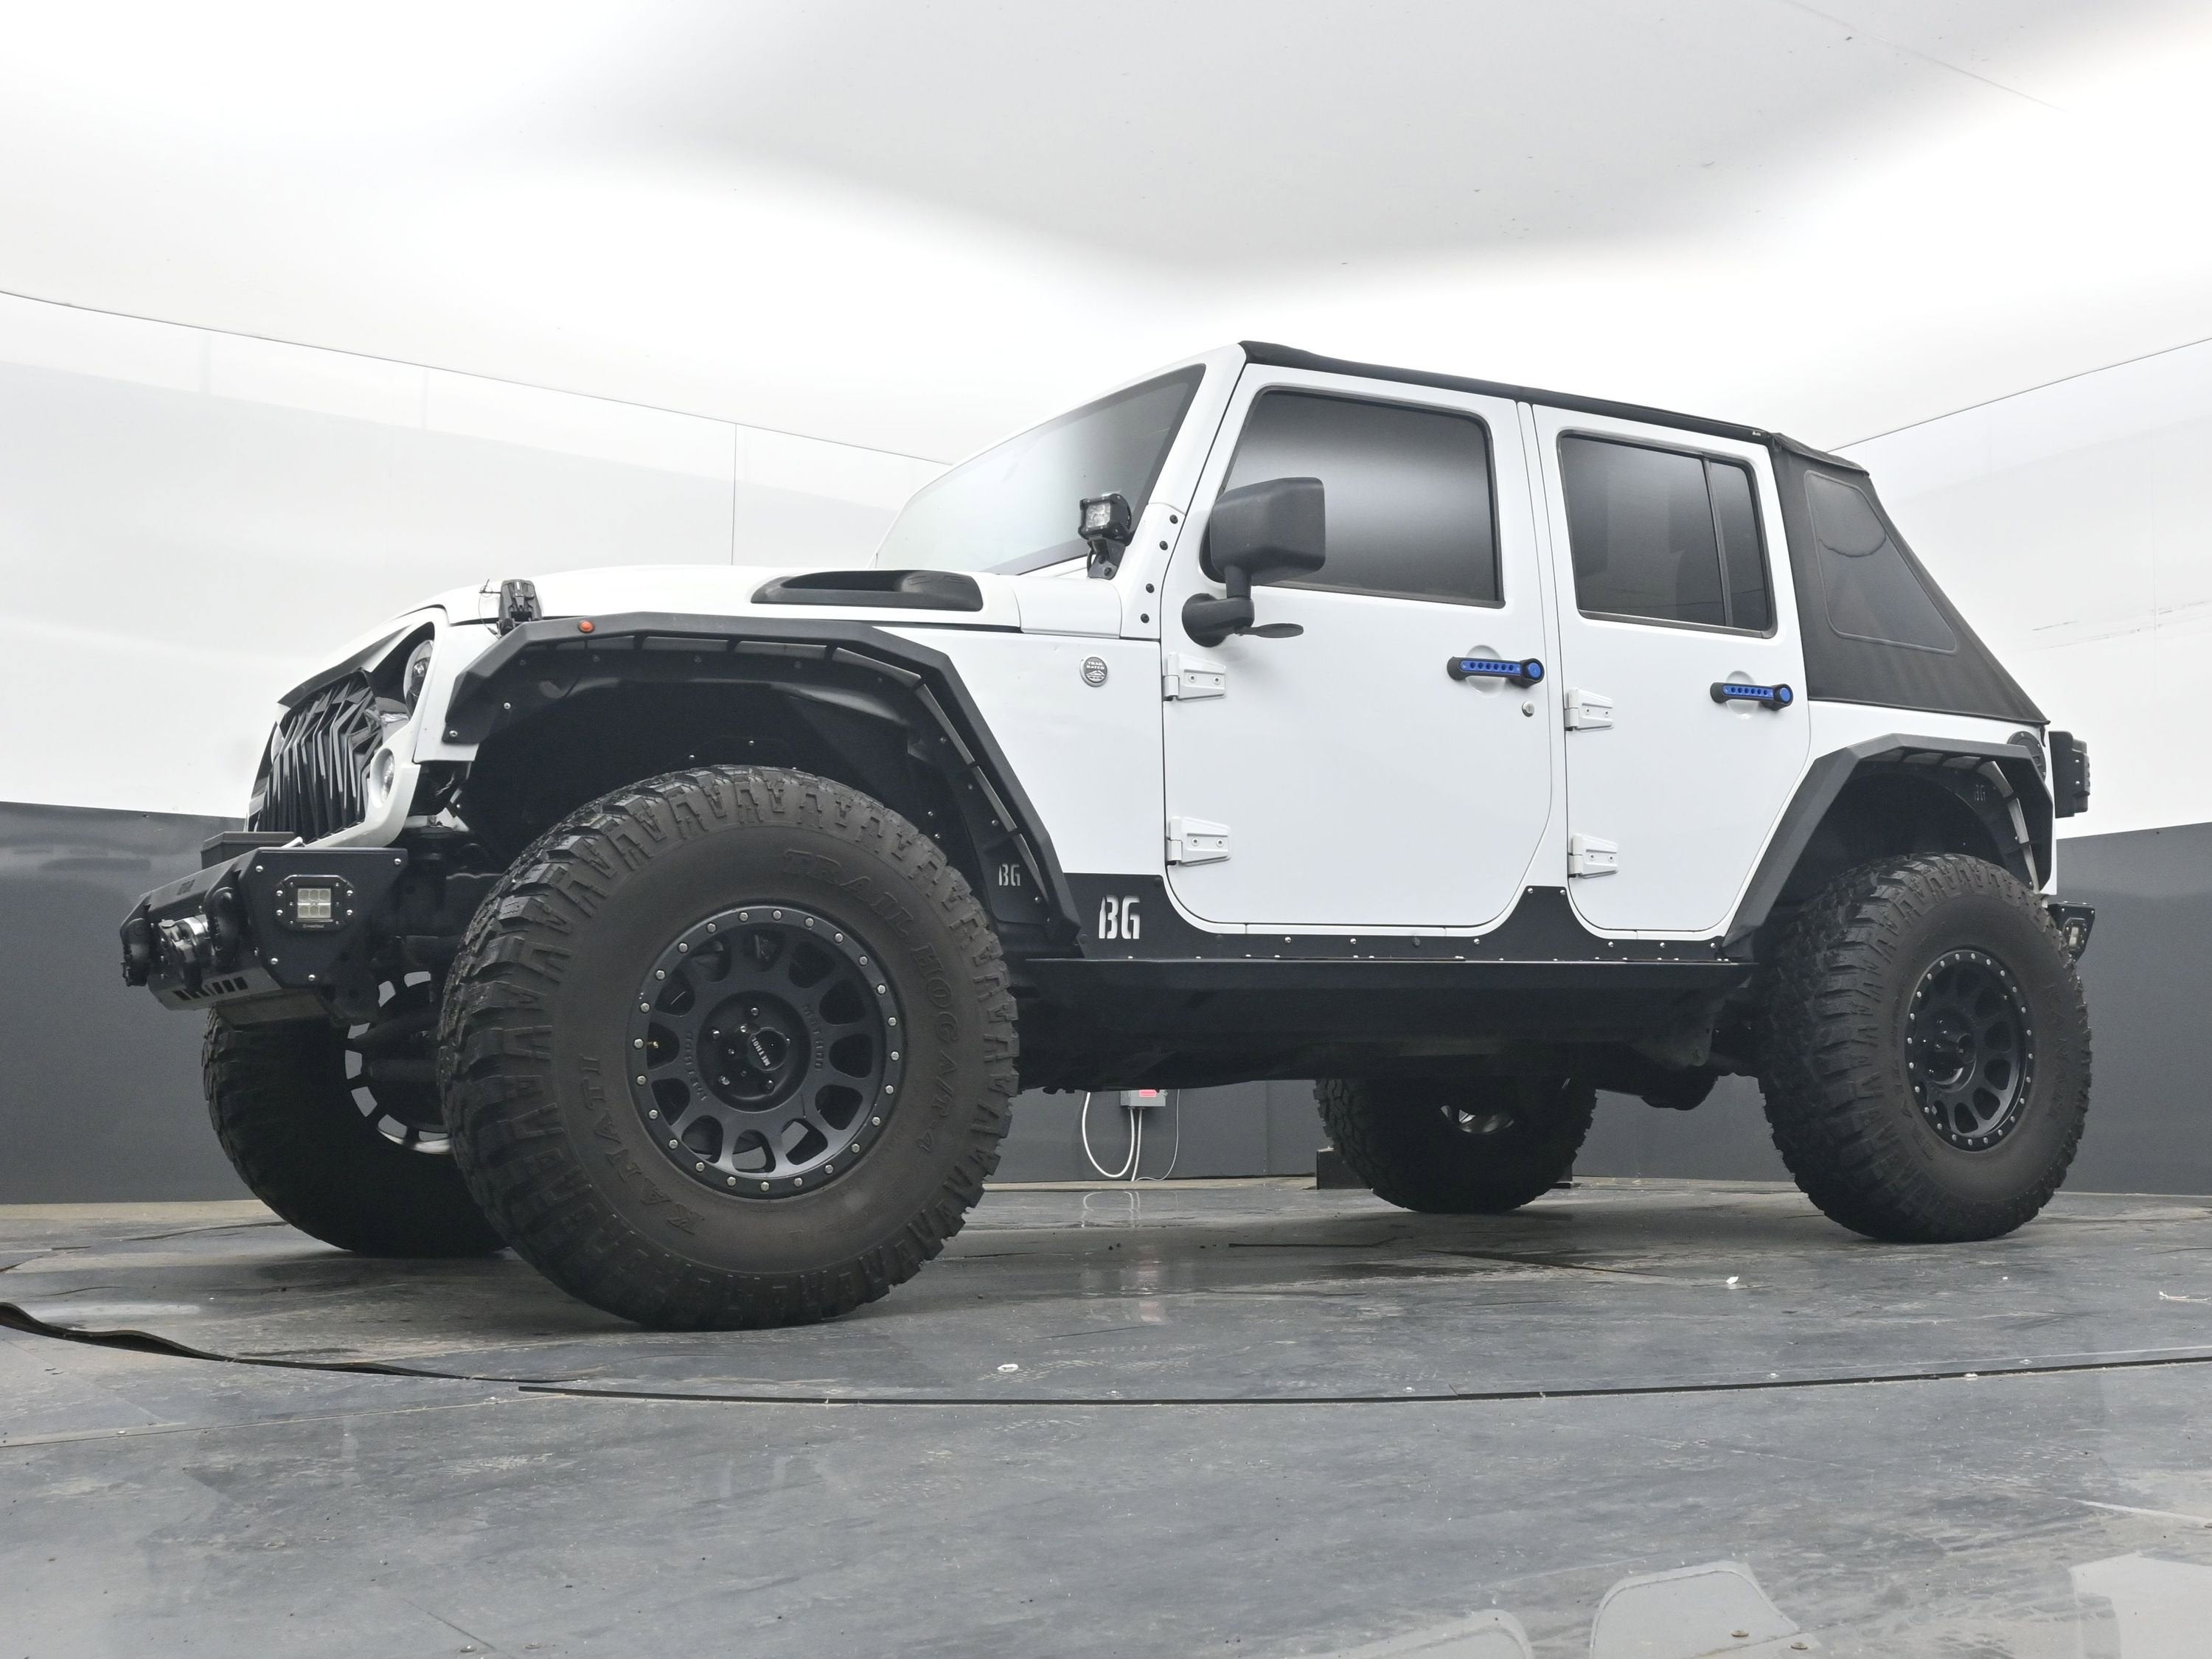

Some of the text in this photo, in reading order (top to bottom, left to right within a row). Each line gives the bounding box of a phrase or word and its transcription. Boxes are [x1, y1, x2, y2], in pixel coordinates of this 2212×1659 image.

[998, 863, 1020, 886] BG
[1098, 894, 1141, 939] BG
[783, 848, 914, 938] TRAIL
[910, 942, 959, 1045] HOG
